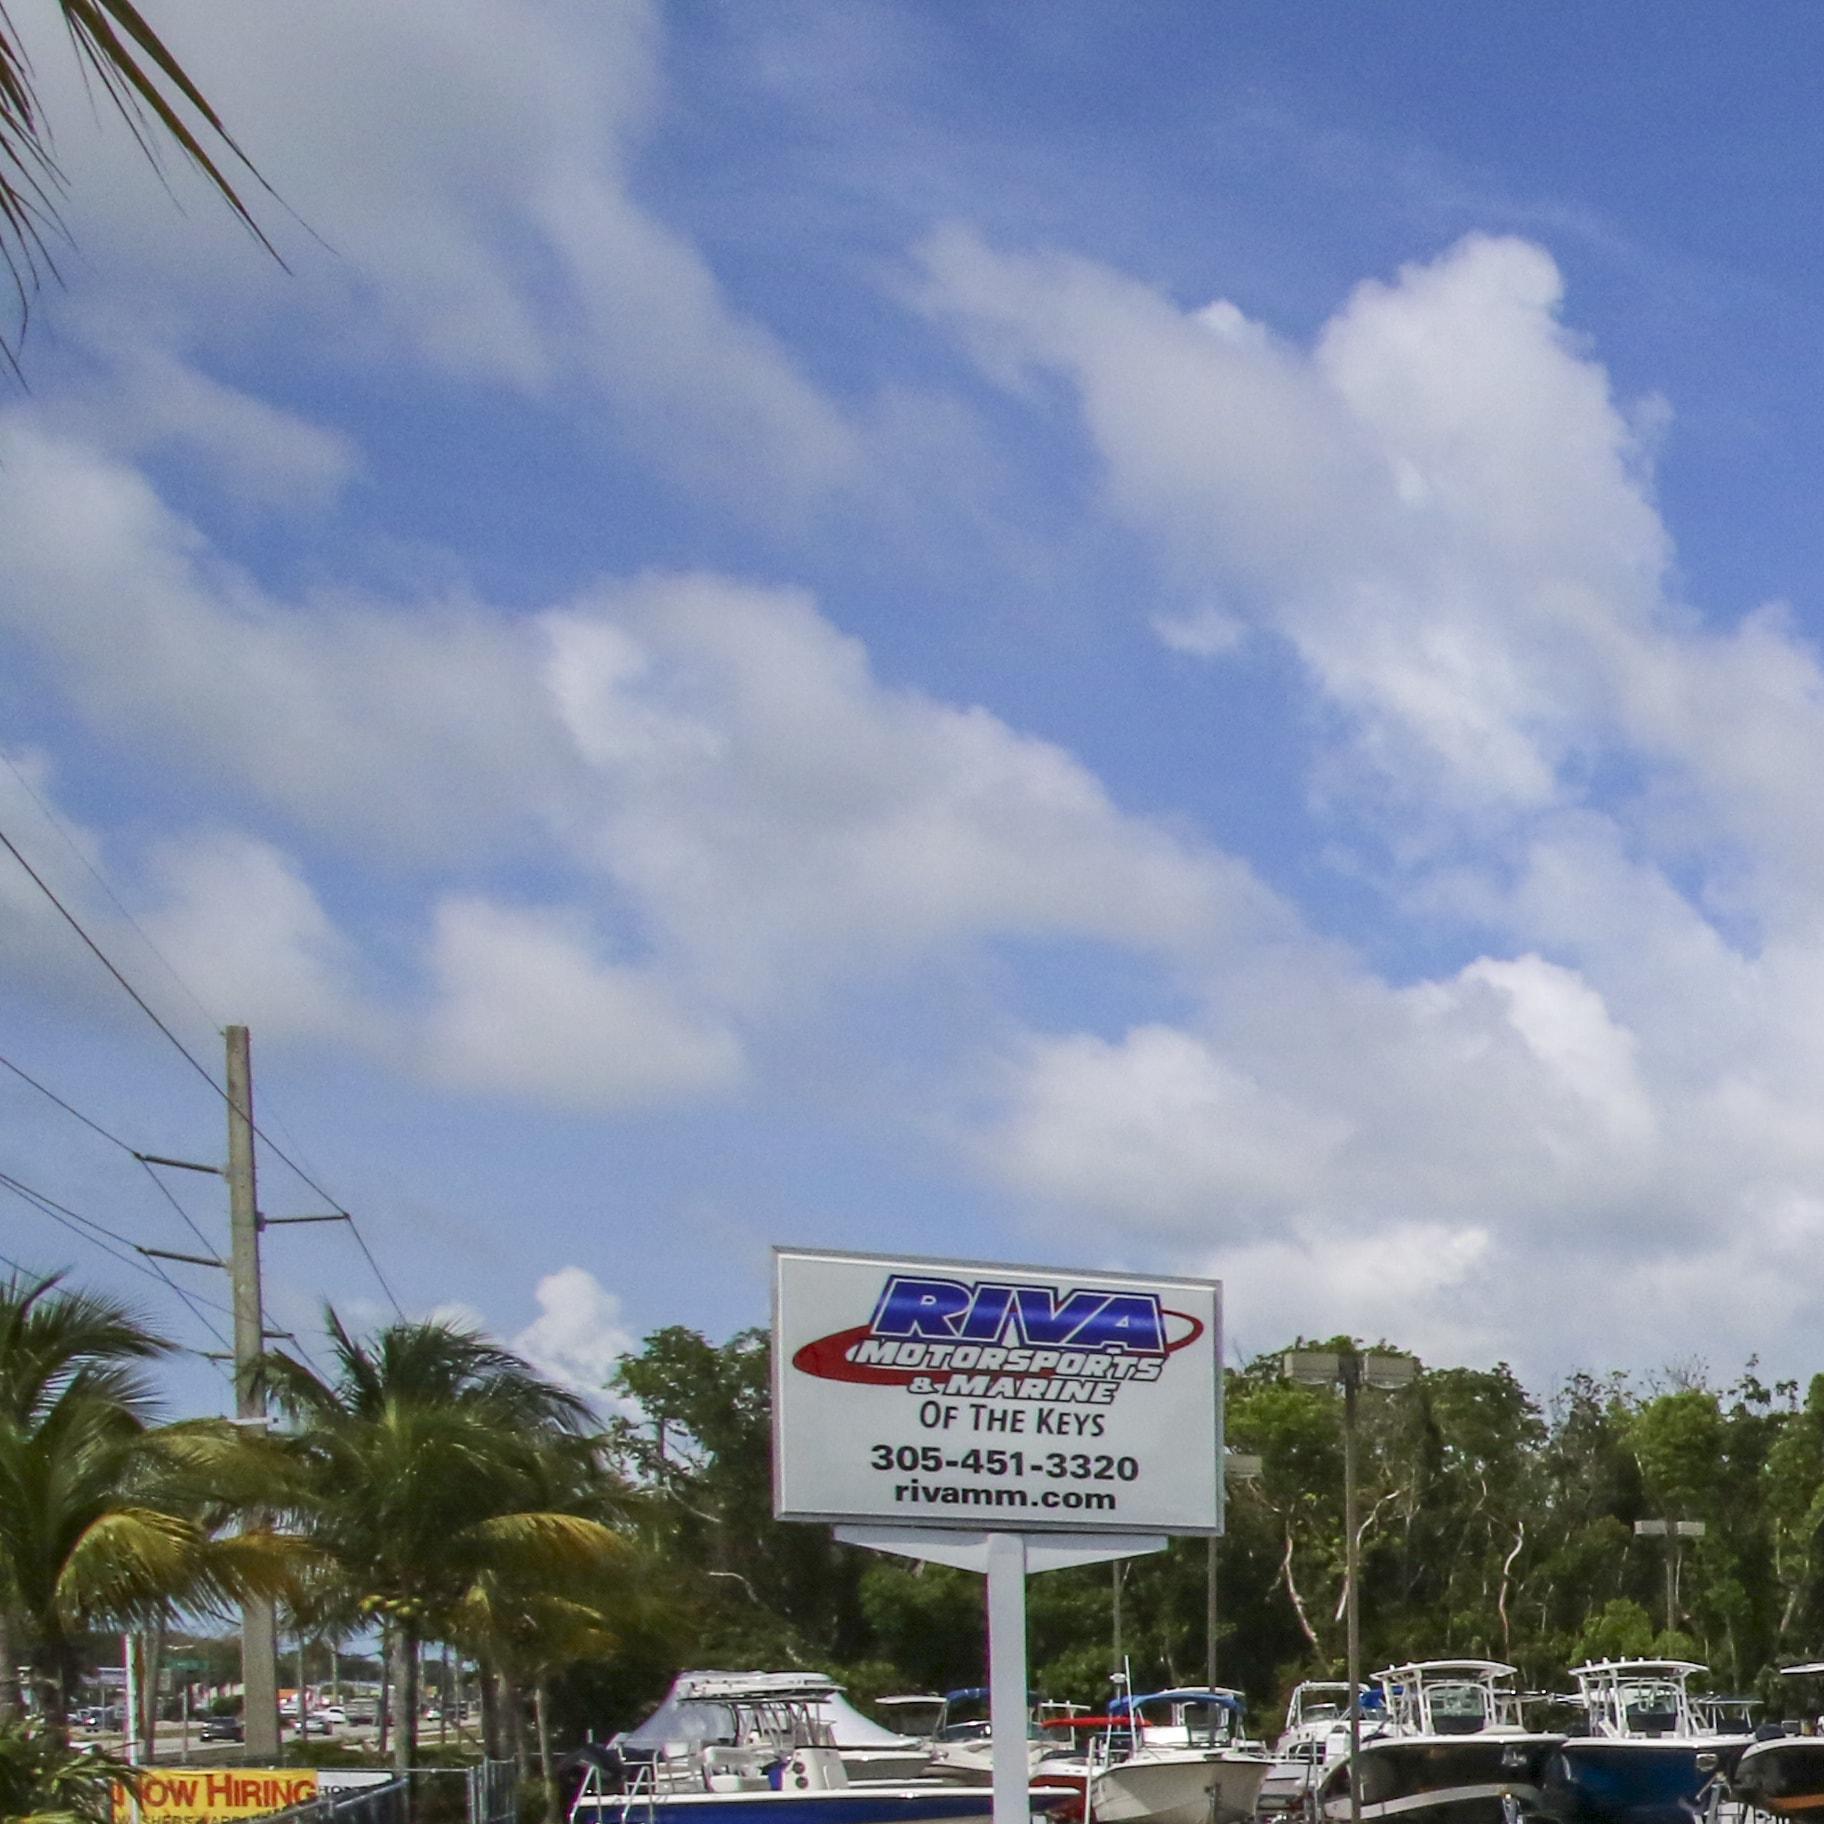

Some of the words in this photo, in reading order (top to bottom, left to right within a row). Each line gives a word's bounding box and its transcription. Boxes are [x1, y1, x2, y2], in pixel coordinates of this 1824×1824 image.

[869, 1275, 1169, 1354] RIVA
[854, 1339, 1166, 1381] MOTORSPORTS
[907, 1376, 939, 1394] &
[943, 1373, 1120, 1404] MARINE
[920, 1401, 958, 1429] OF
[970, 1404, 1025, 1433] THE
[1037, 1408, 1105, 1436] KEYS
[871, 1445, 1139, 1481] 305-451-3320
[895, 1480, 1116, 1510] rivamm.com
[206, 1773, 316, 1807] HIRING
